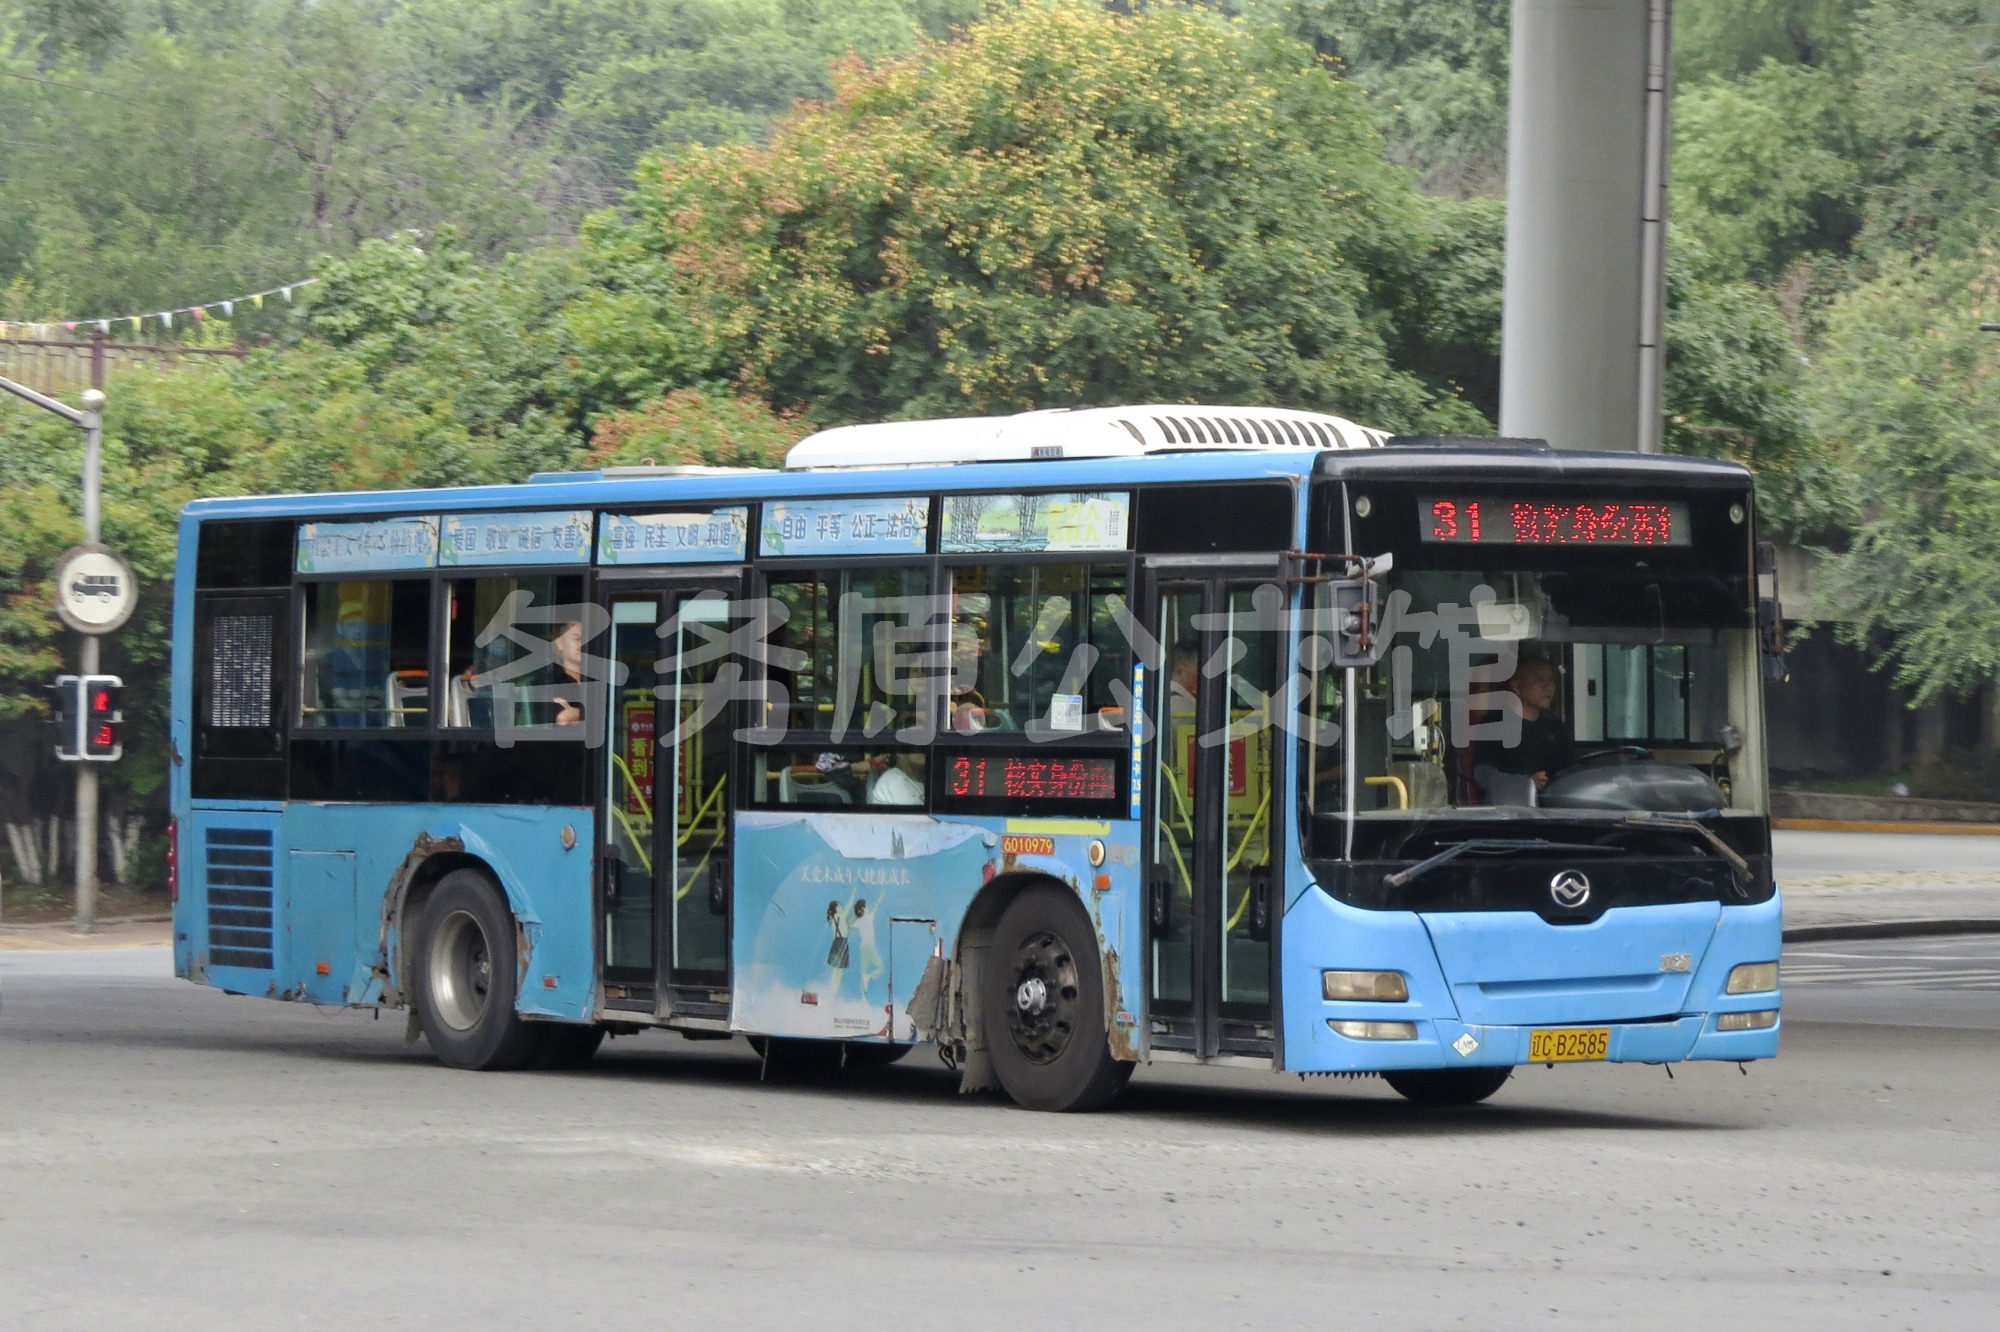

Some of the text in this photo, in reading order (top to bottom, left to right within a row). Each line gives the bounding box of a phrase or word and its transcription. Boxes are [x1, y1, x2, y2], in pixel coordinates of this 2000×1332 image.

[611, 521, 732, 551] 富强 民主 文明 和谐
[782, 511, 913, 542] 自由 平等 公正 法治
[1432, 502, 1480, 542] 31
[452, 523, 577, 553] 爱国 敬业 诚信 友善
[953, 757, 987, 796] 31
[1003, 837, 1054, 854] 6010979
